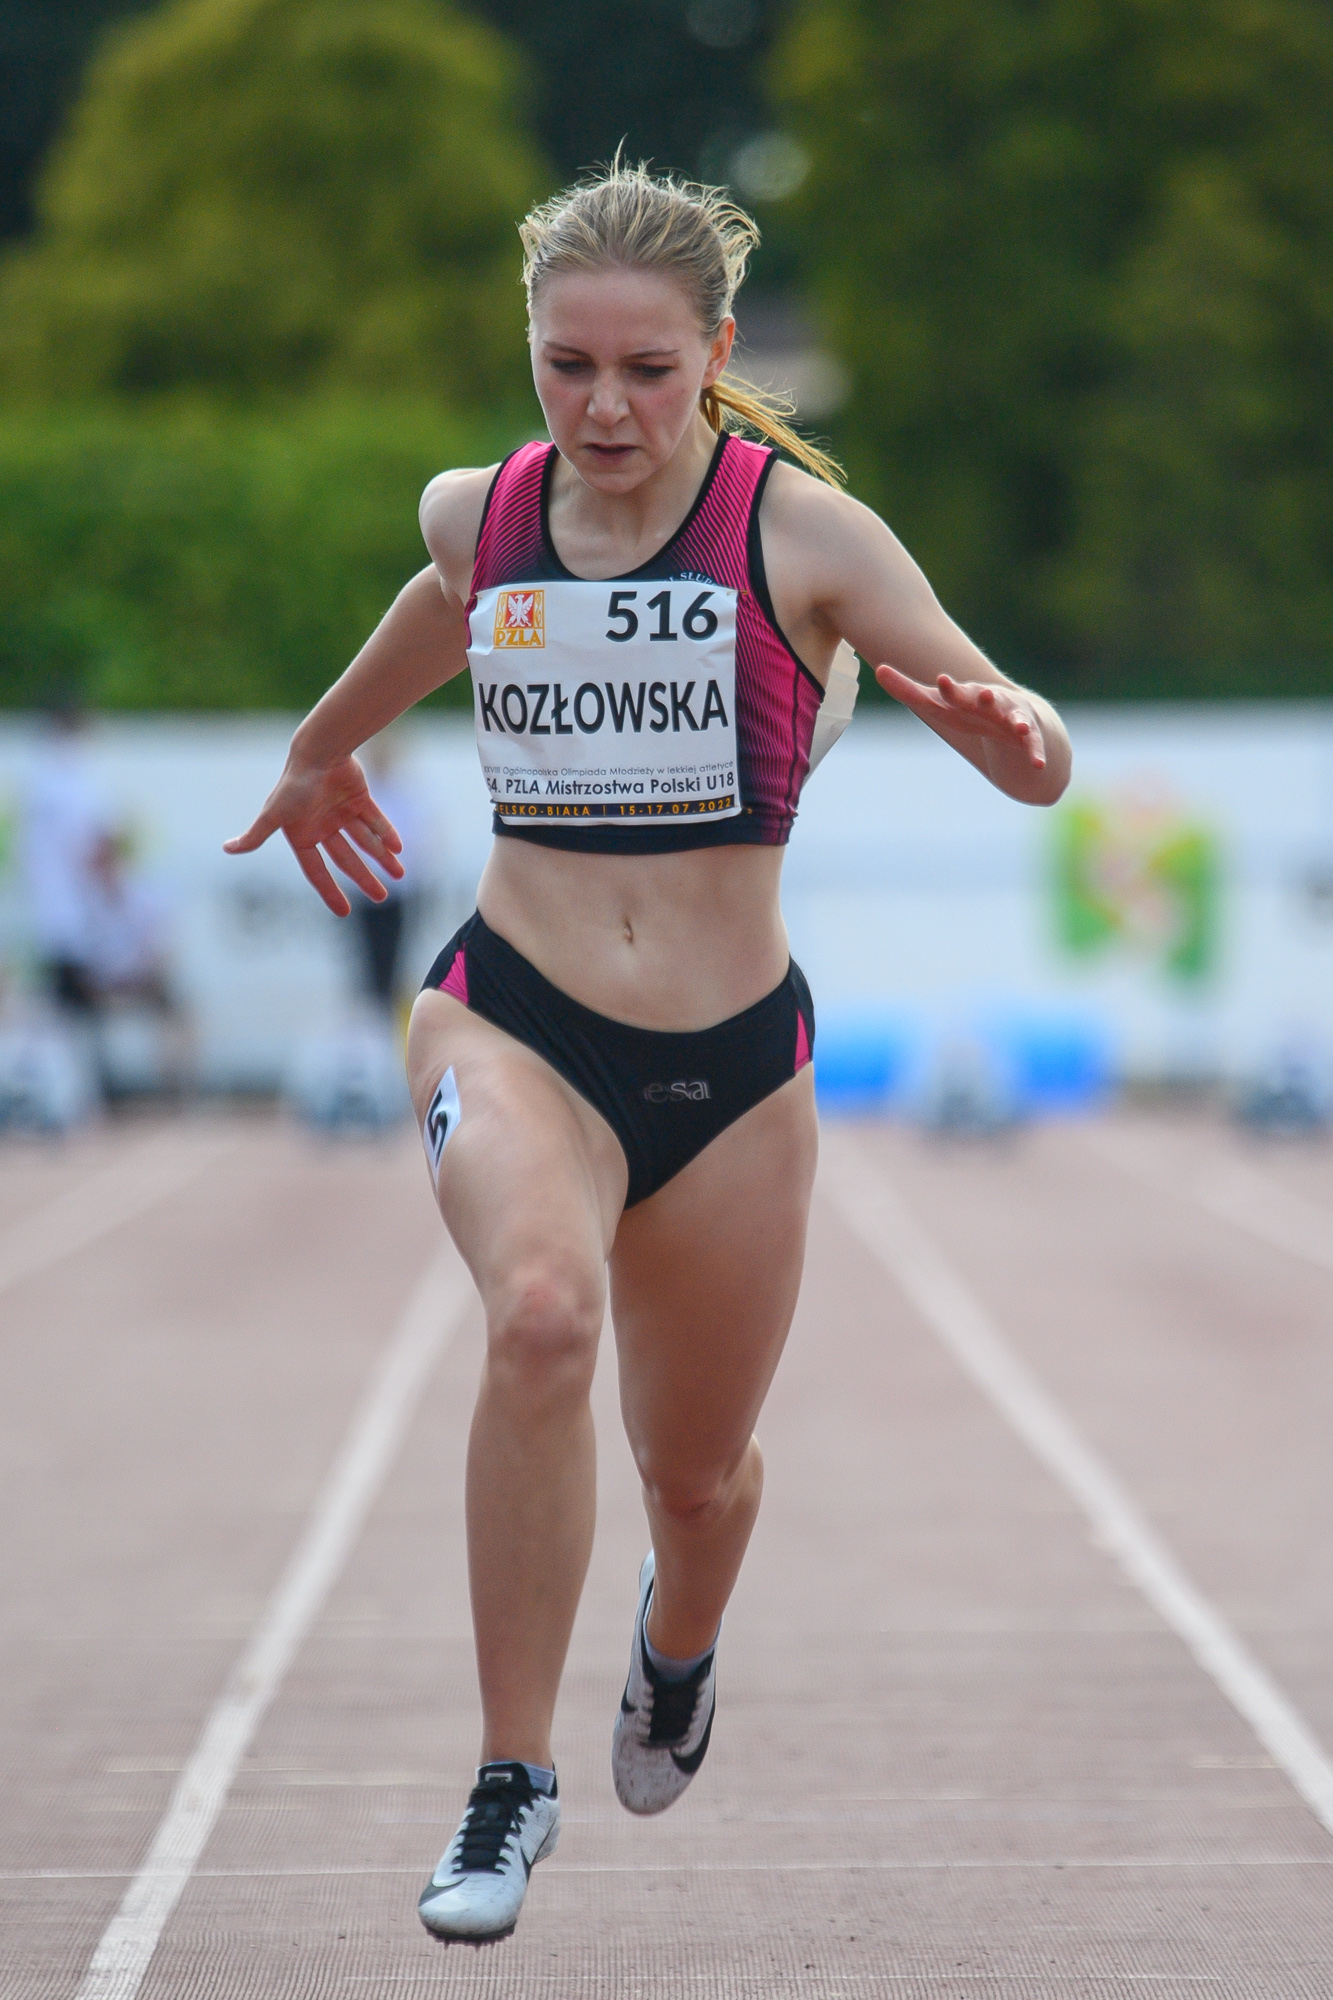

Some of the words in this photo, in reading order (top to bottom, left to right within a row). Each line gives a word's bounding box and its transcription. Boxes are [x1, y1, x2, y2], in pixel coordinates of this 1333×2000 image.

[680, 572, 718, 587] SŁUP
[605, 590, 718, 643] 516
[495, 630, 542, 646] PZLA
[478, 679, 728, 735] KOZŁOWSKA
[502, 766, 558, 777] Ogólnopolska
[560, 766, 606, 777] Olimpiada
[609, 767, 655, 777] Młodzieży
[667, 765, 697, 775] lekkiej
[699, 760, 734, 773] atletyce
[506, 779, 541, 795] PZLA
[545, 779, 644, 796] Mistrzostwa
[650, 777, 701, 794] Polski
[706, 771, 734, 791] U18
[499, 805, 590, 816] ELSKO-BIAŁA
